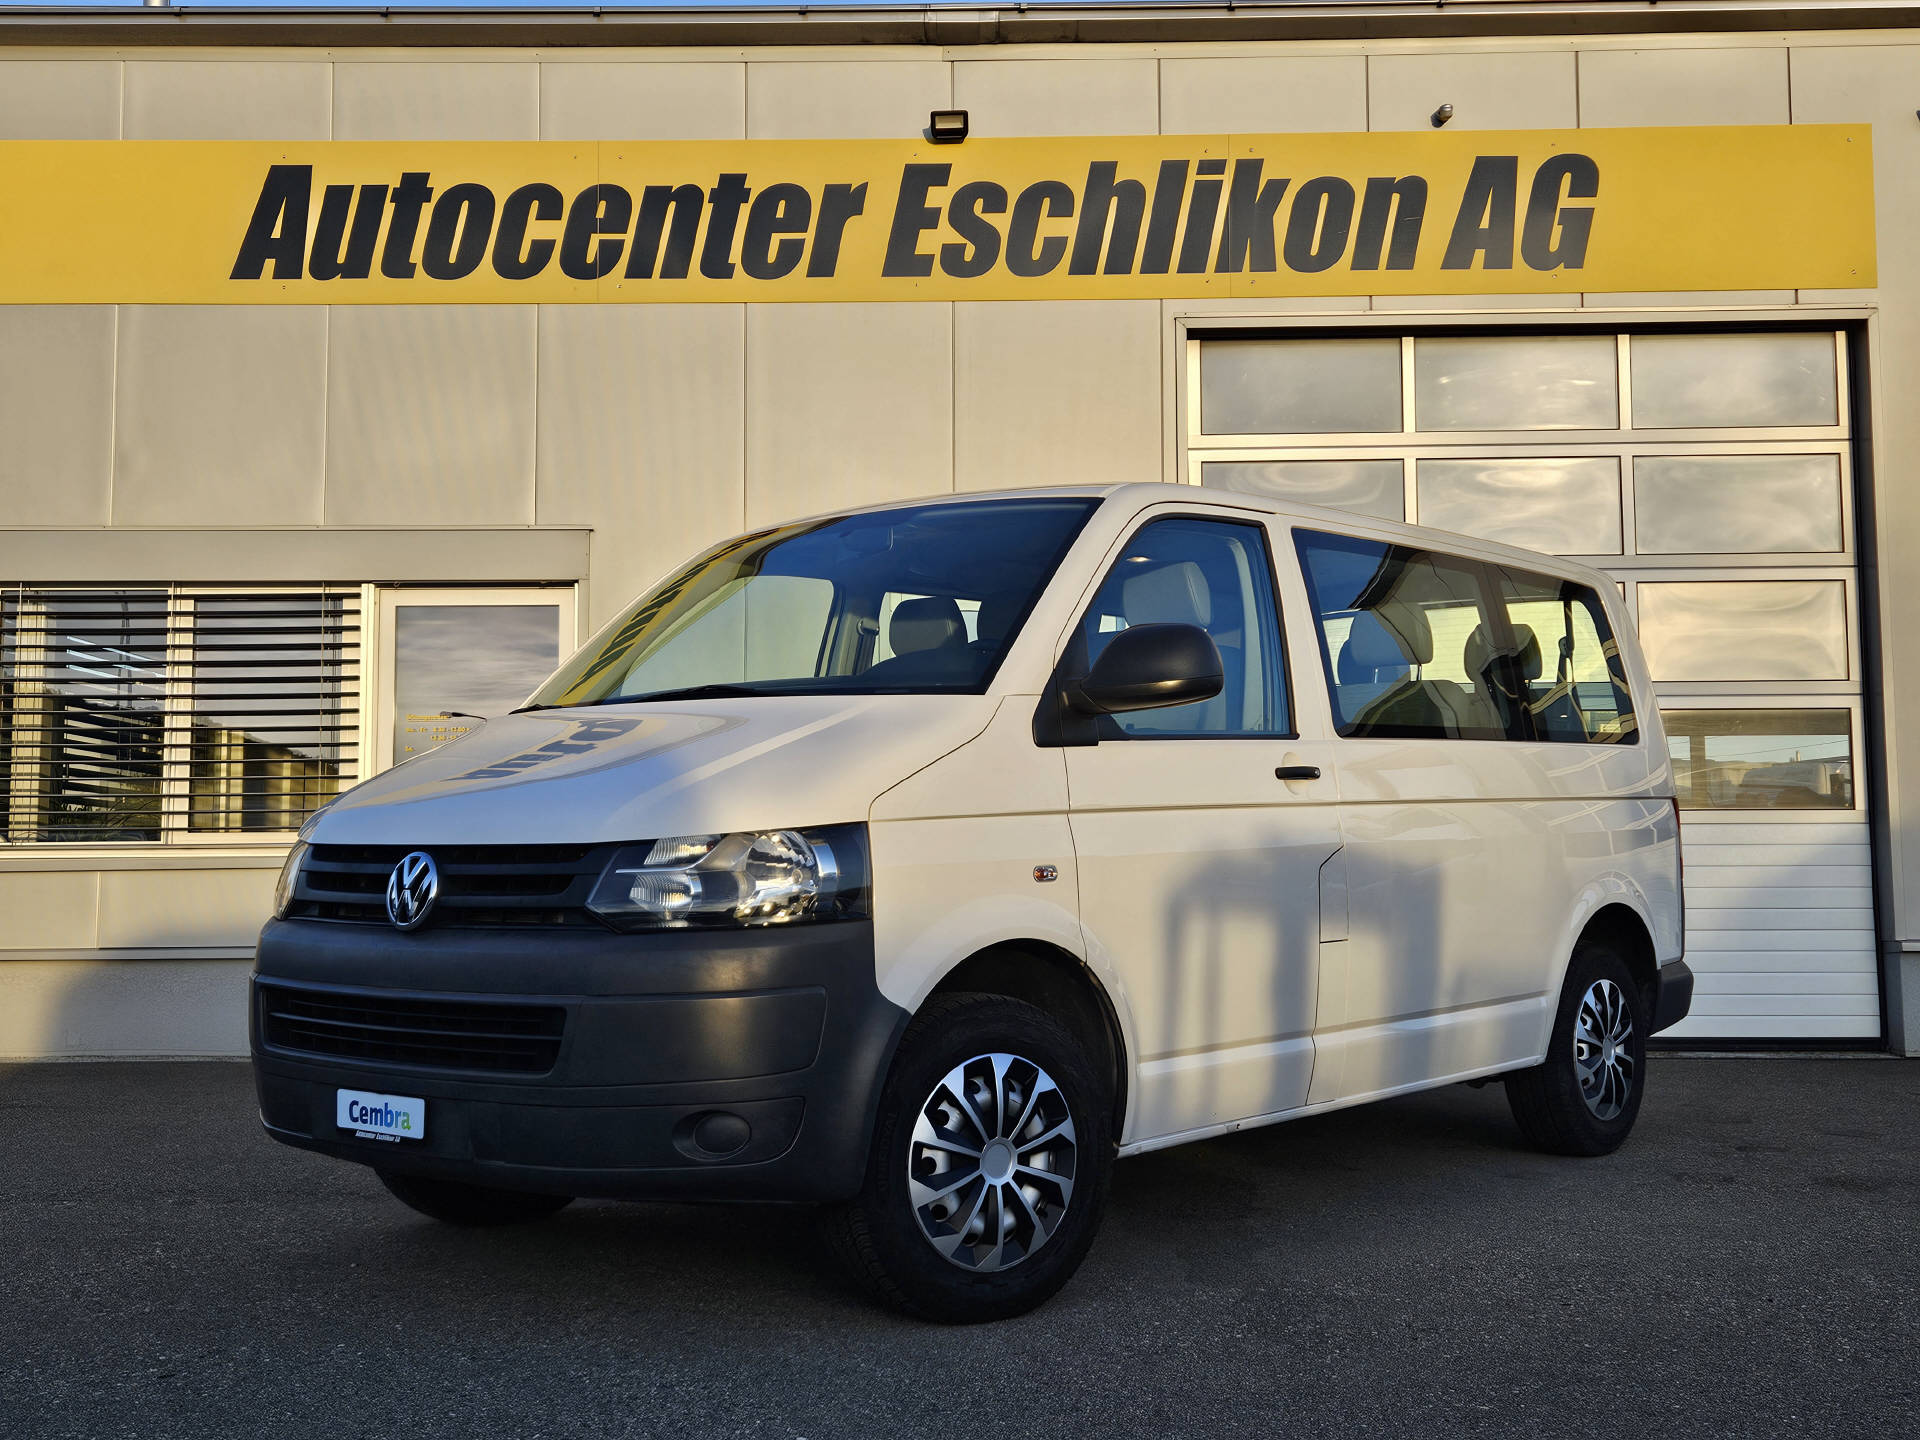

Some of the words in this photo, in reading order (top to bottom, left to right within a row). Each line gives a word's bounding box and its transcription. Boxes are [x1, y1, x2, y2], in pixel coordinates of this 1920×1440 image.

[230, 165, 868, 281] Autocenter
[881, 158, 1428, 279] Eschlikon
[1440, 153, 1600, 272] AG
[348, 1099, 412, 1131] Cembra
